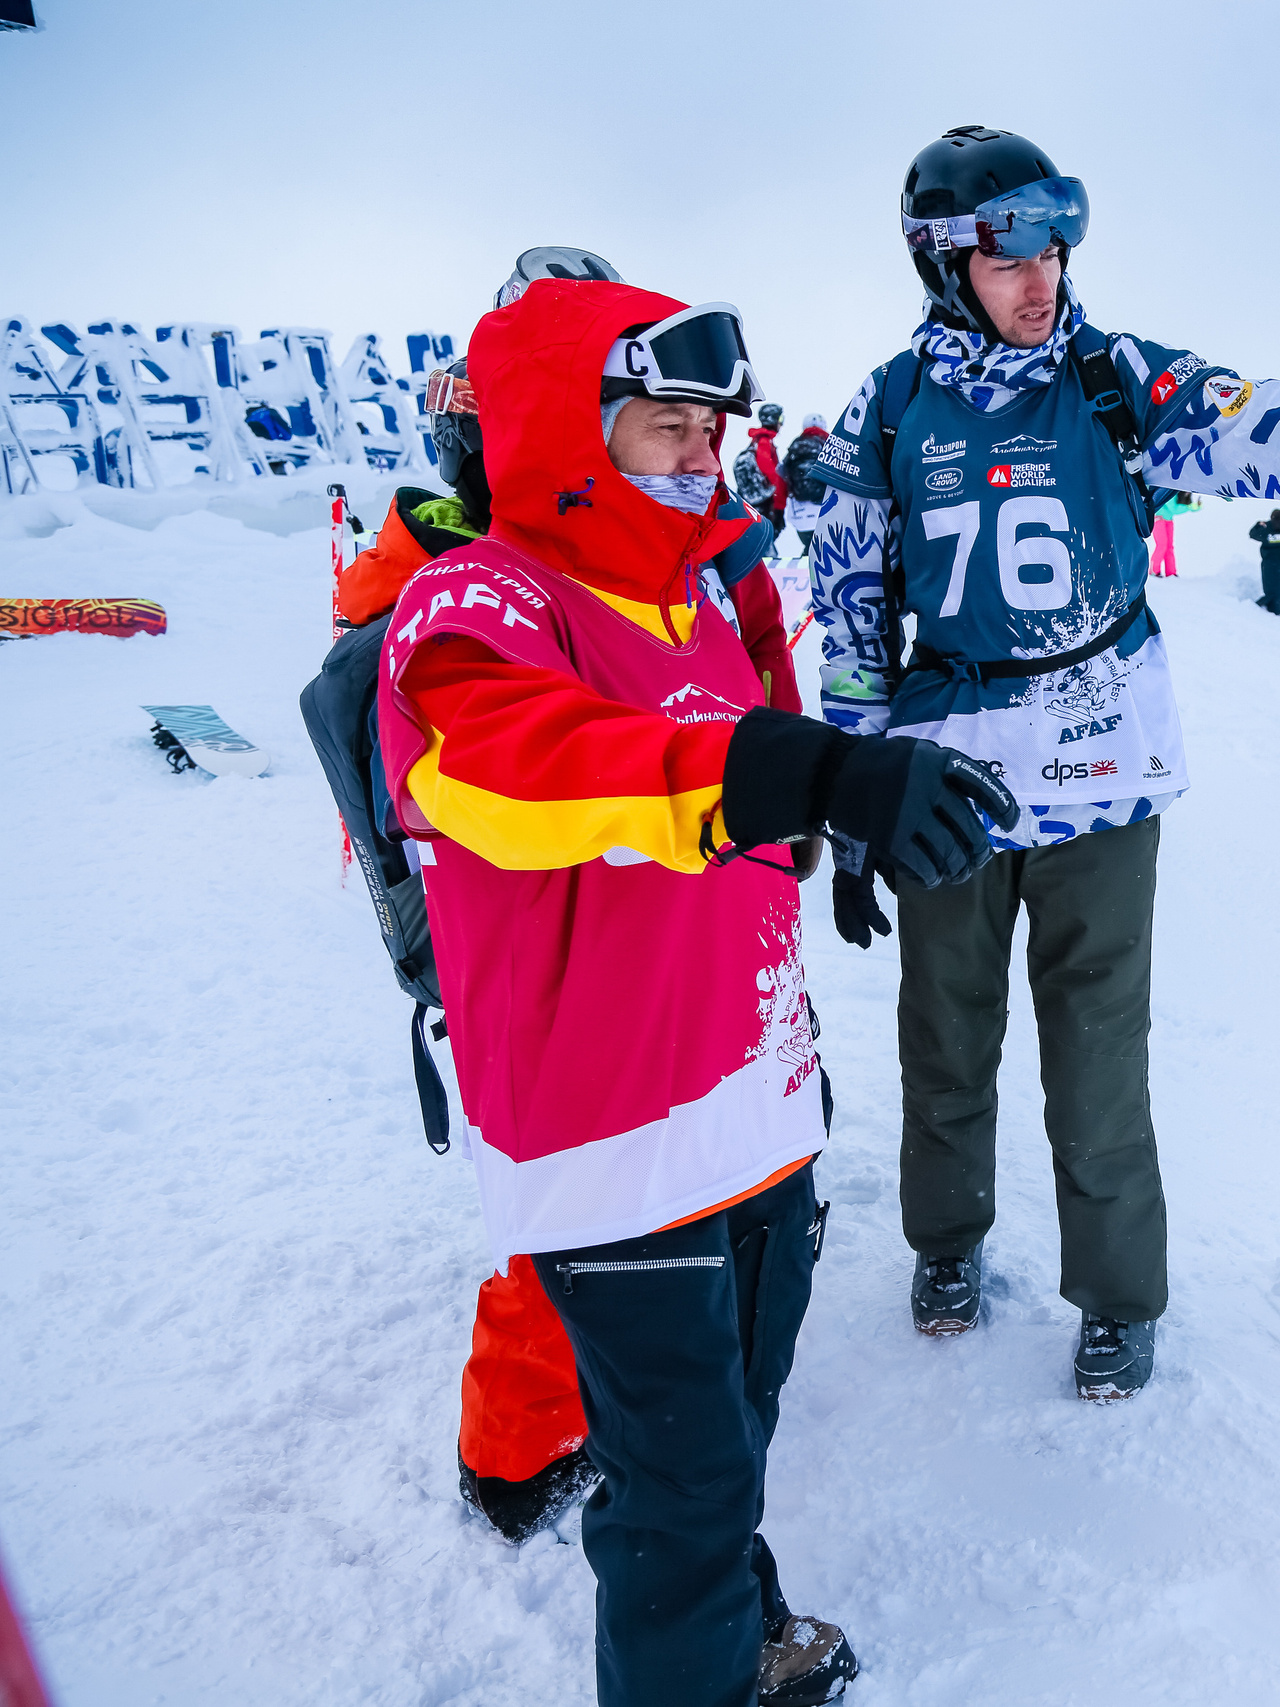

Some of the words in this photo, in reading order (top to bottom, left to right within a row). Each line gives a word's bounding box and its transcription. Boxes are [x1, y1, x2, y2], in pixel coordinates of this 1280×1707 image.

[625, 340, 649, 377] C
[935, 440, 966, 454] ГАЗПРОМ
[817, 451, 860, 477] QUALIFIER
[1010, 463, 1051, 473] FREERIDE
[1010, 471, 1046, 480] WORLD
[1010, 477, 1057, 488] QUALIFIER
[921, 496, 1073, 618] 76
[1109, 682, 1127, 702] FEST
[1058, 713, 1123, 745] AFAF
[961, 762, 983, 780] Black
[982, 776, 1010, 807] Diamond
[1041, 757, 1089, 787] dps
[783, 1053, 817, 1098] AFAF
